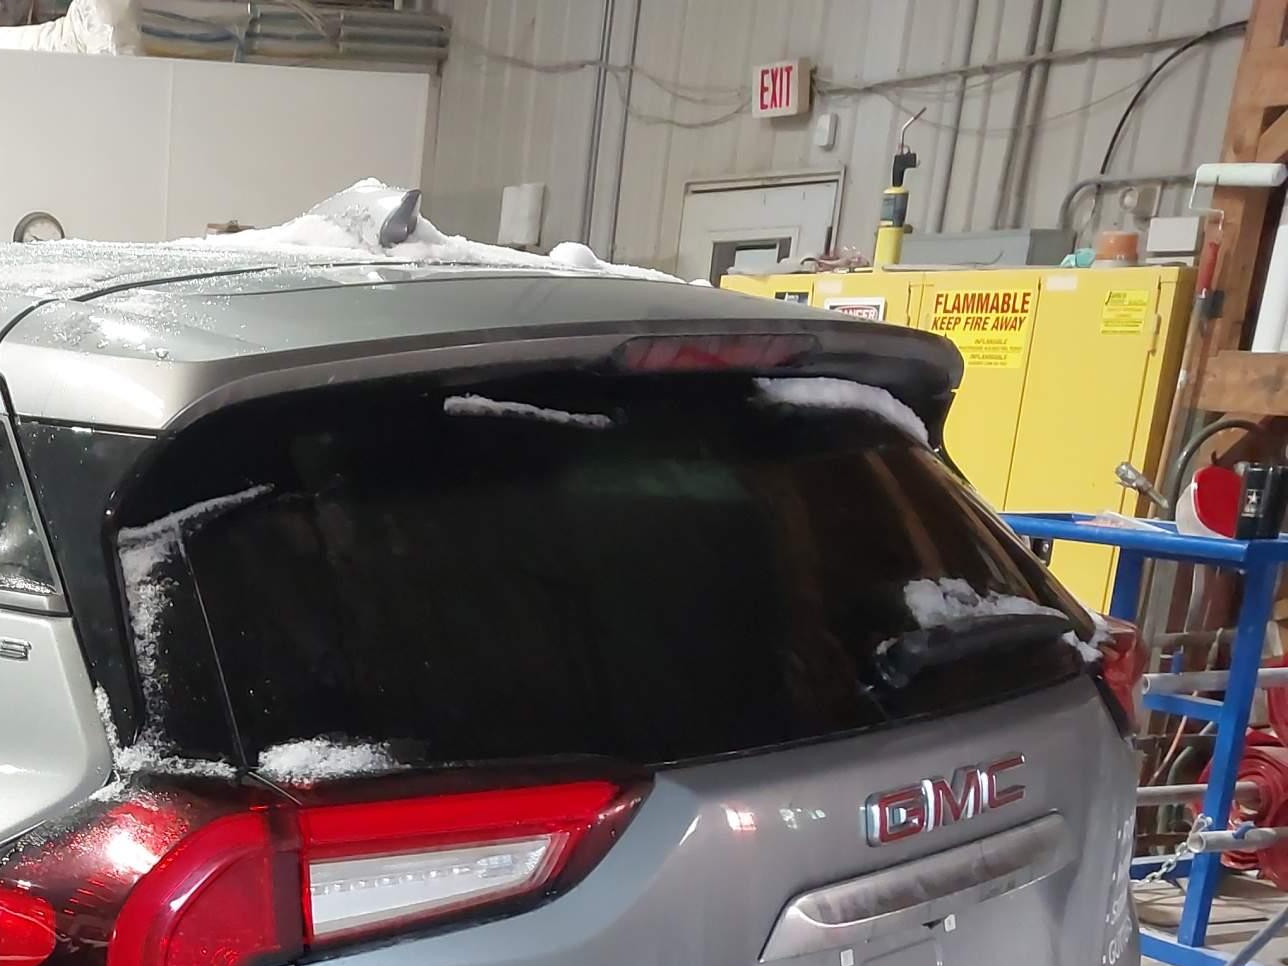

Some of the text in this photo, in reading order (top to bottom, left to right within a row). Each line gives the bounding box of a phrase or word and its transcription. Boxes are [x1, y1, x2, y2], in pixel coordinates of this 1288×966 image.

[760, 65, 793, 110] EXIT
[934, 292, 1032, 314] FLAMMABLE
[931, 316, 1026, 331] KEEP FIRE AWAY
[865, 753, 1025, 847] GMC
